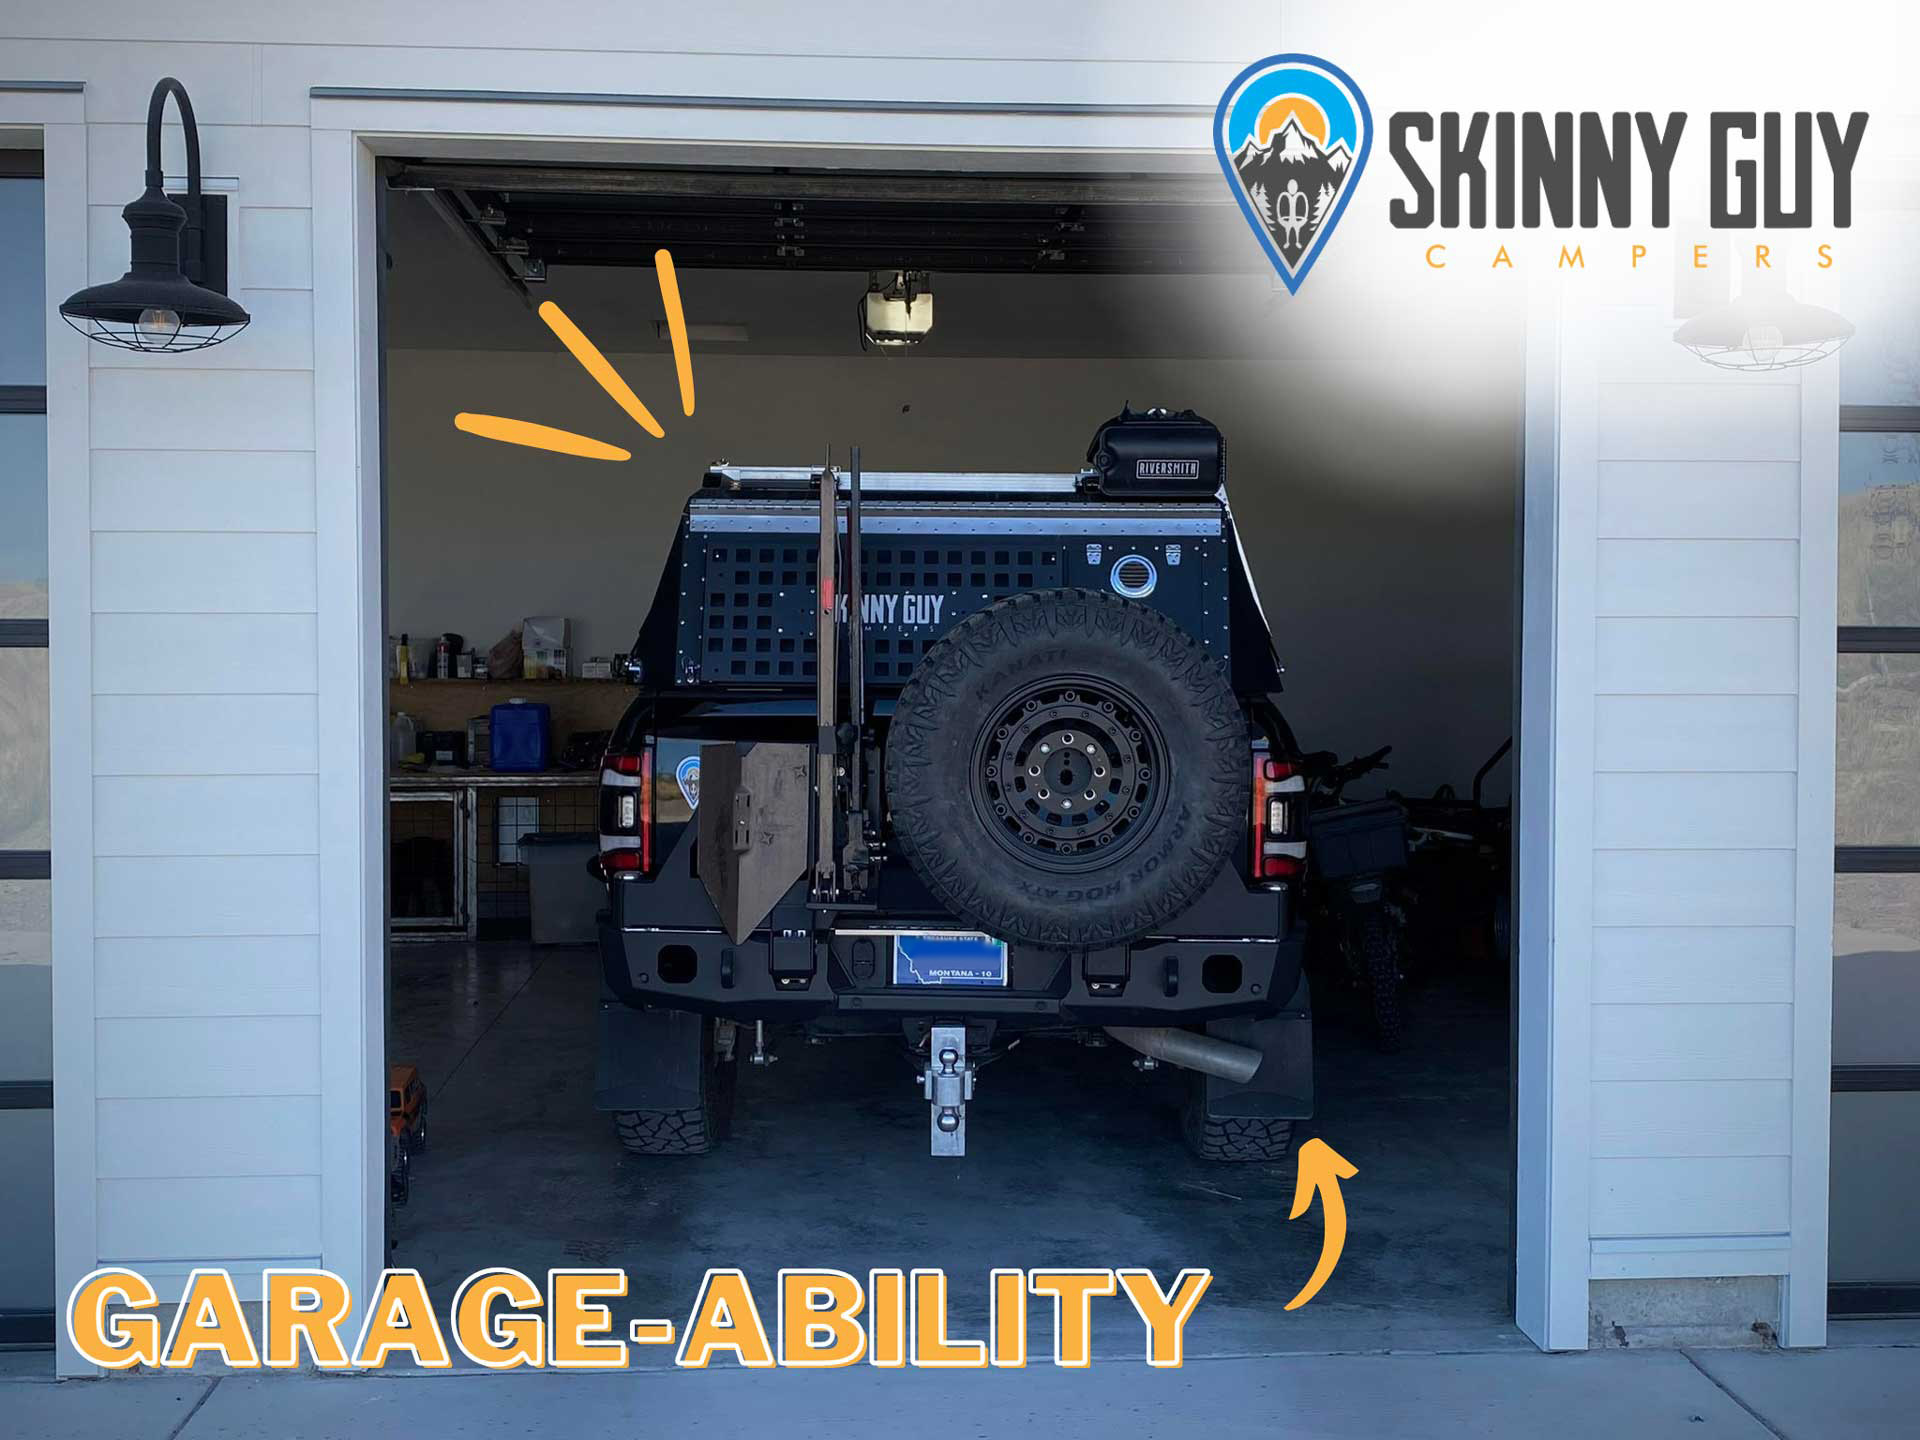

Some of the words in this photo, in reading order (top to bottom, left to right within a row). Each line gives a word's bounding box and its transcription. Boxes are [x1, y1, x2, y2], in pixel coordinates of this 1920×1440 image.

[1139, 462, 1197, 475] RIVERSMITH
[834, 594, 899, 624] KNNY
[903, 594, 945, 624] GUY
[1127, 803, 1191, 884] ARMOR
[929, 969, 974, 977] MONTANA
